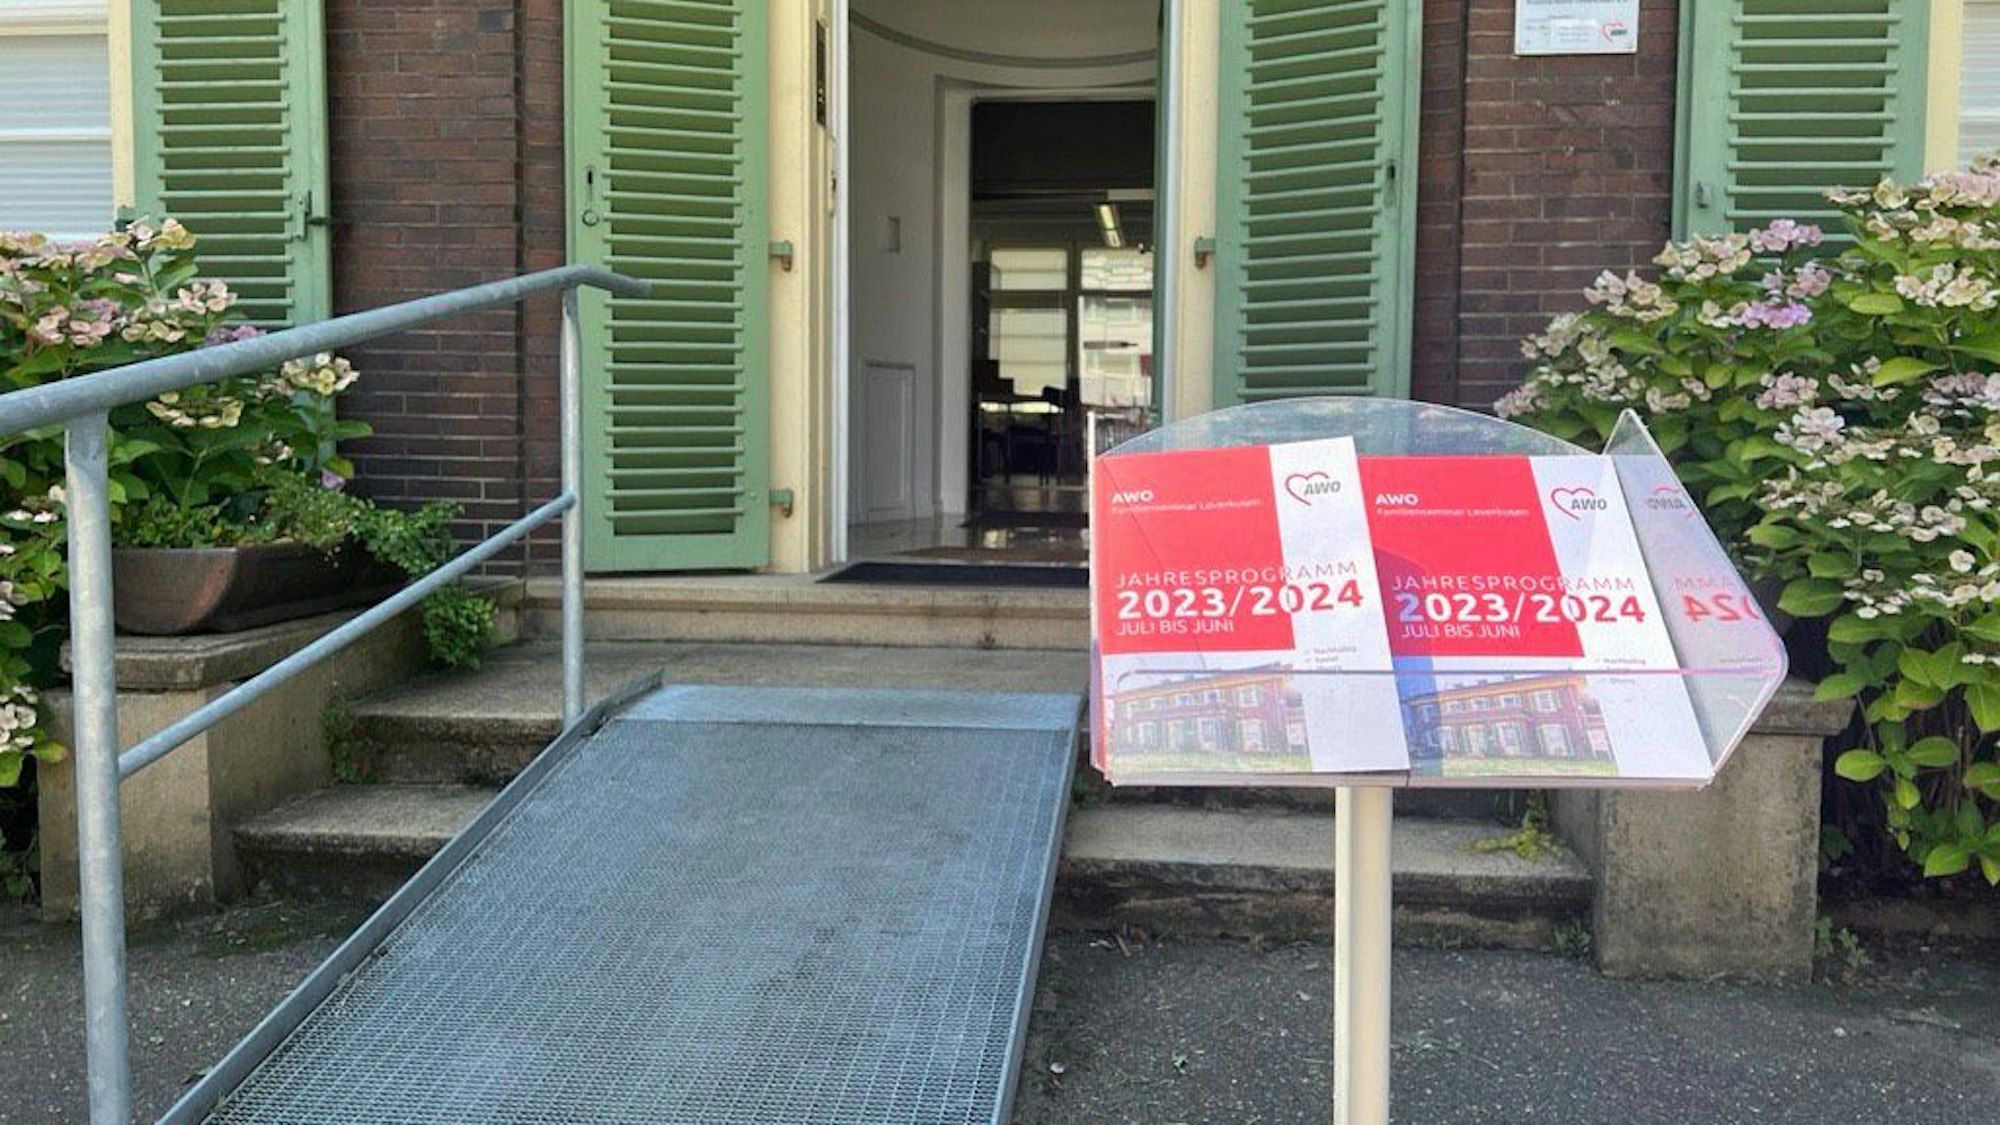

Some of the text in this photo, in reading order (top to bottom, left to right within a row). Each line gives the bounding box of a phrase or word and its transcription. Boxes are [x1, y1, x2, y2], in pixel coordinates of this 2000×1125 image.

[1304, 481, 1341, 496] AWO
[1111, 490, 1154, 504] AWO
[1376, 493, 1419, 506] AWO
[1571, 497, 1608, 512] AWO
[1116, 562, 1358, 589] JAHRESPROGRAMM
[1393, 575, 1635, 592] JAHRESPROGRAMM
[1117, 580, 1363, 619] 2023/2024
[1395, 593, 1645, 624] 2023/2024
[1117, 617, 1235, 636] JULI BIS JUNI
[1401, 624, 1520, 640] JULI BIS JUNI
